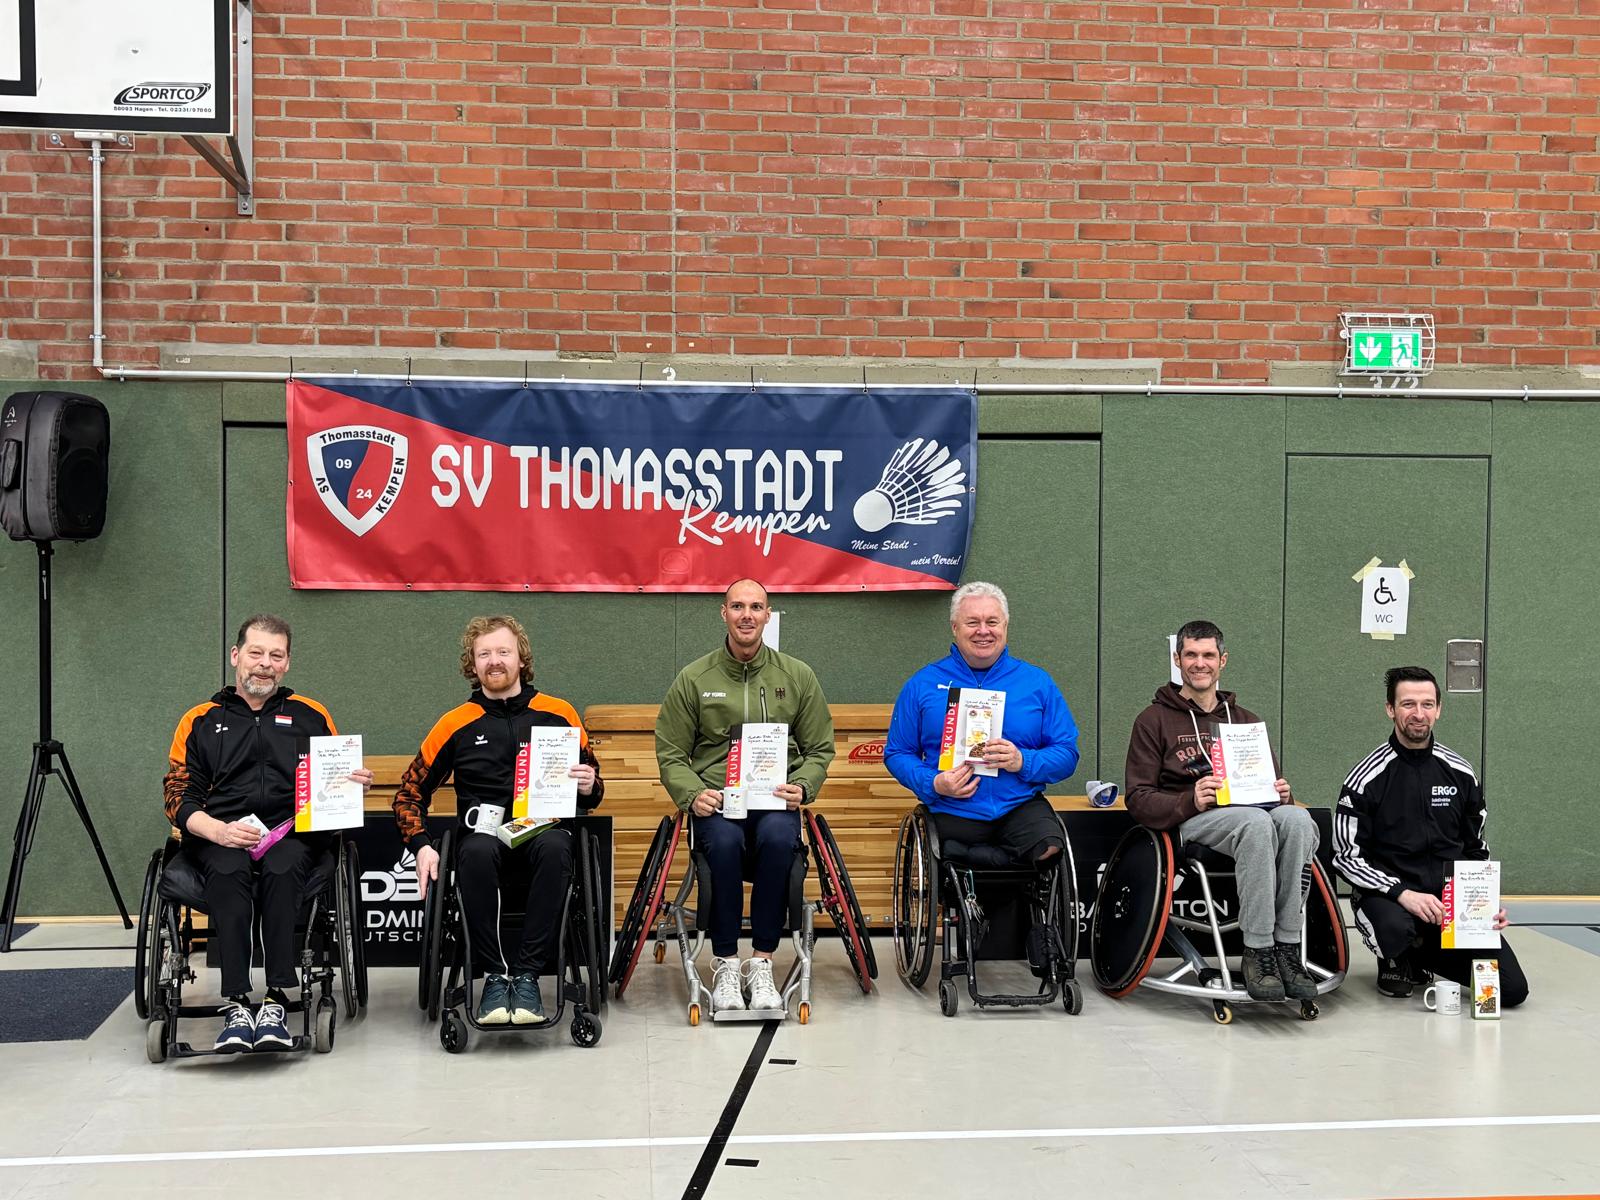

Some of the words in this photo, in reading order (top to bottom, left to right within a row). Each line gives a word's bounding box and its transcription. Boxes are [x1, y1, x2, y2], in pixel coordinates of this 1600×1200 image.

[128, 87, 195, 100] SPORTCO
[320, 430, 396, 445] Thomasstadt
[335, 458, 353, 469] 09
[315, 477, 330, 494] SV
[375, 457, 406, 514] KEMPEN
[431, 444, 492, 508] SV
[510, 445, 843, 512] THOMASSTADT
[356, 488, 373, 499] 24
[678, 488, 832, 556] Kempen
[851, 539, 879, 550] Meine
[881, 540, 910, 550] Stadt
[910, 555, 931, 565] mein
[932, 553, 962, 565] Verein!
[1375, 614, 1394, 623] WC
[943, 701, 957, 757] URKUNDE
[728, 738, 739, 785] RKUNDE
[517, 741, 529, 802] URKUNDE
[298, 753, 308, 816] URKUNDE
[1431, 785, 1458, 796] ERGO
[1443, 875, 1453, 934] URKUNDE
